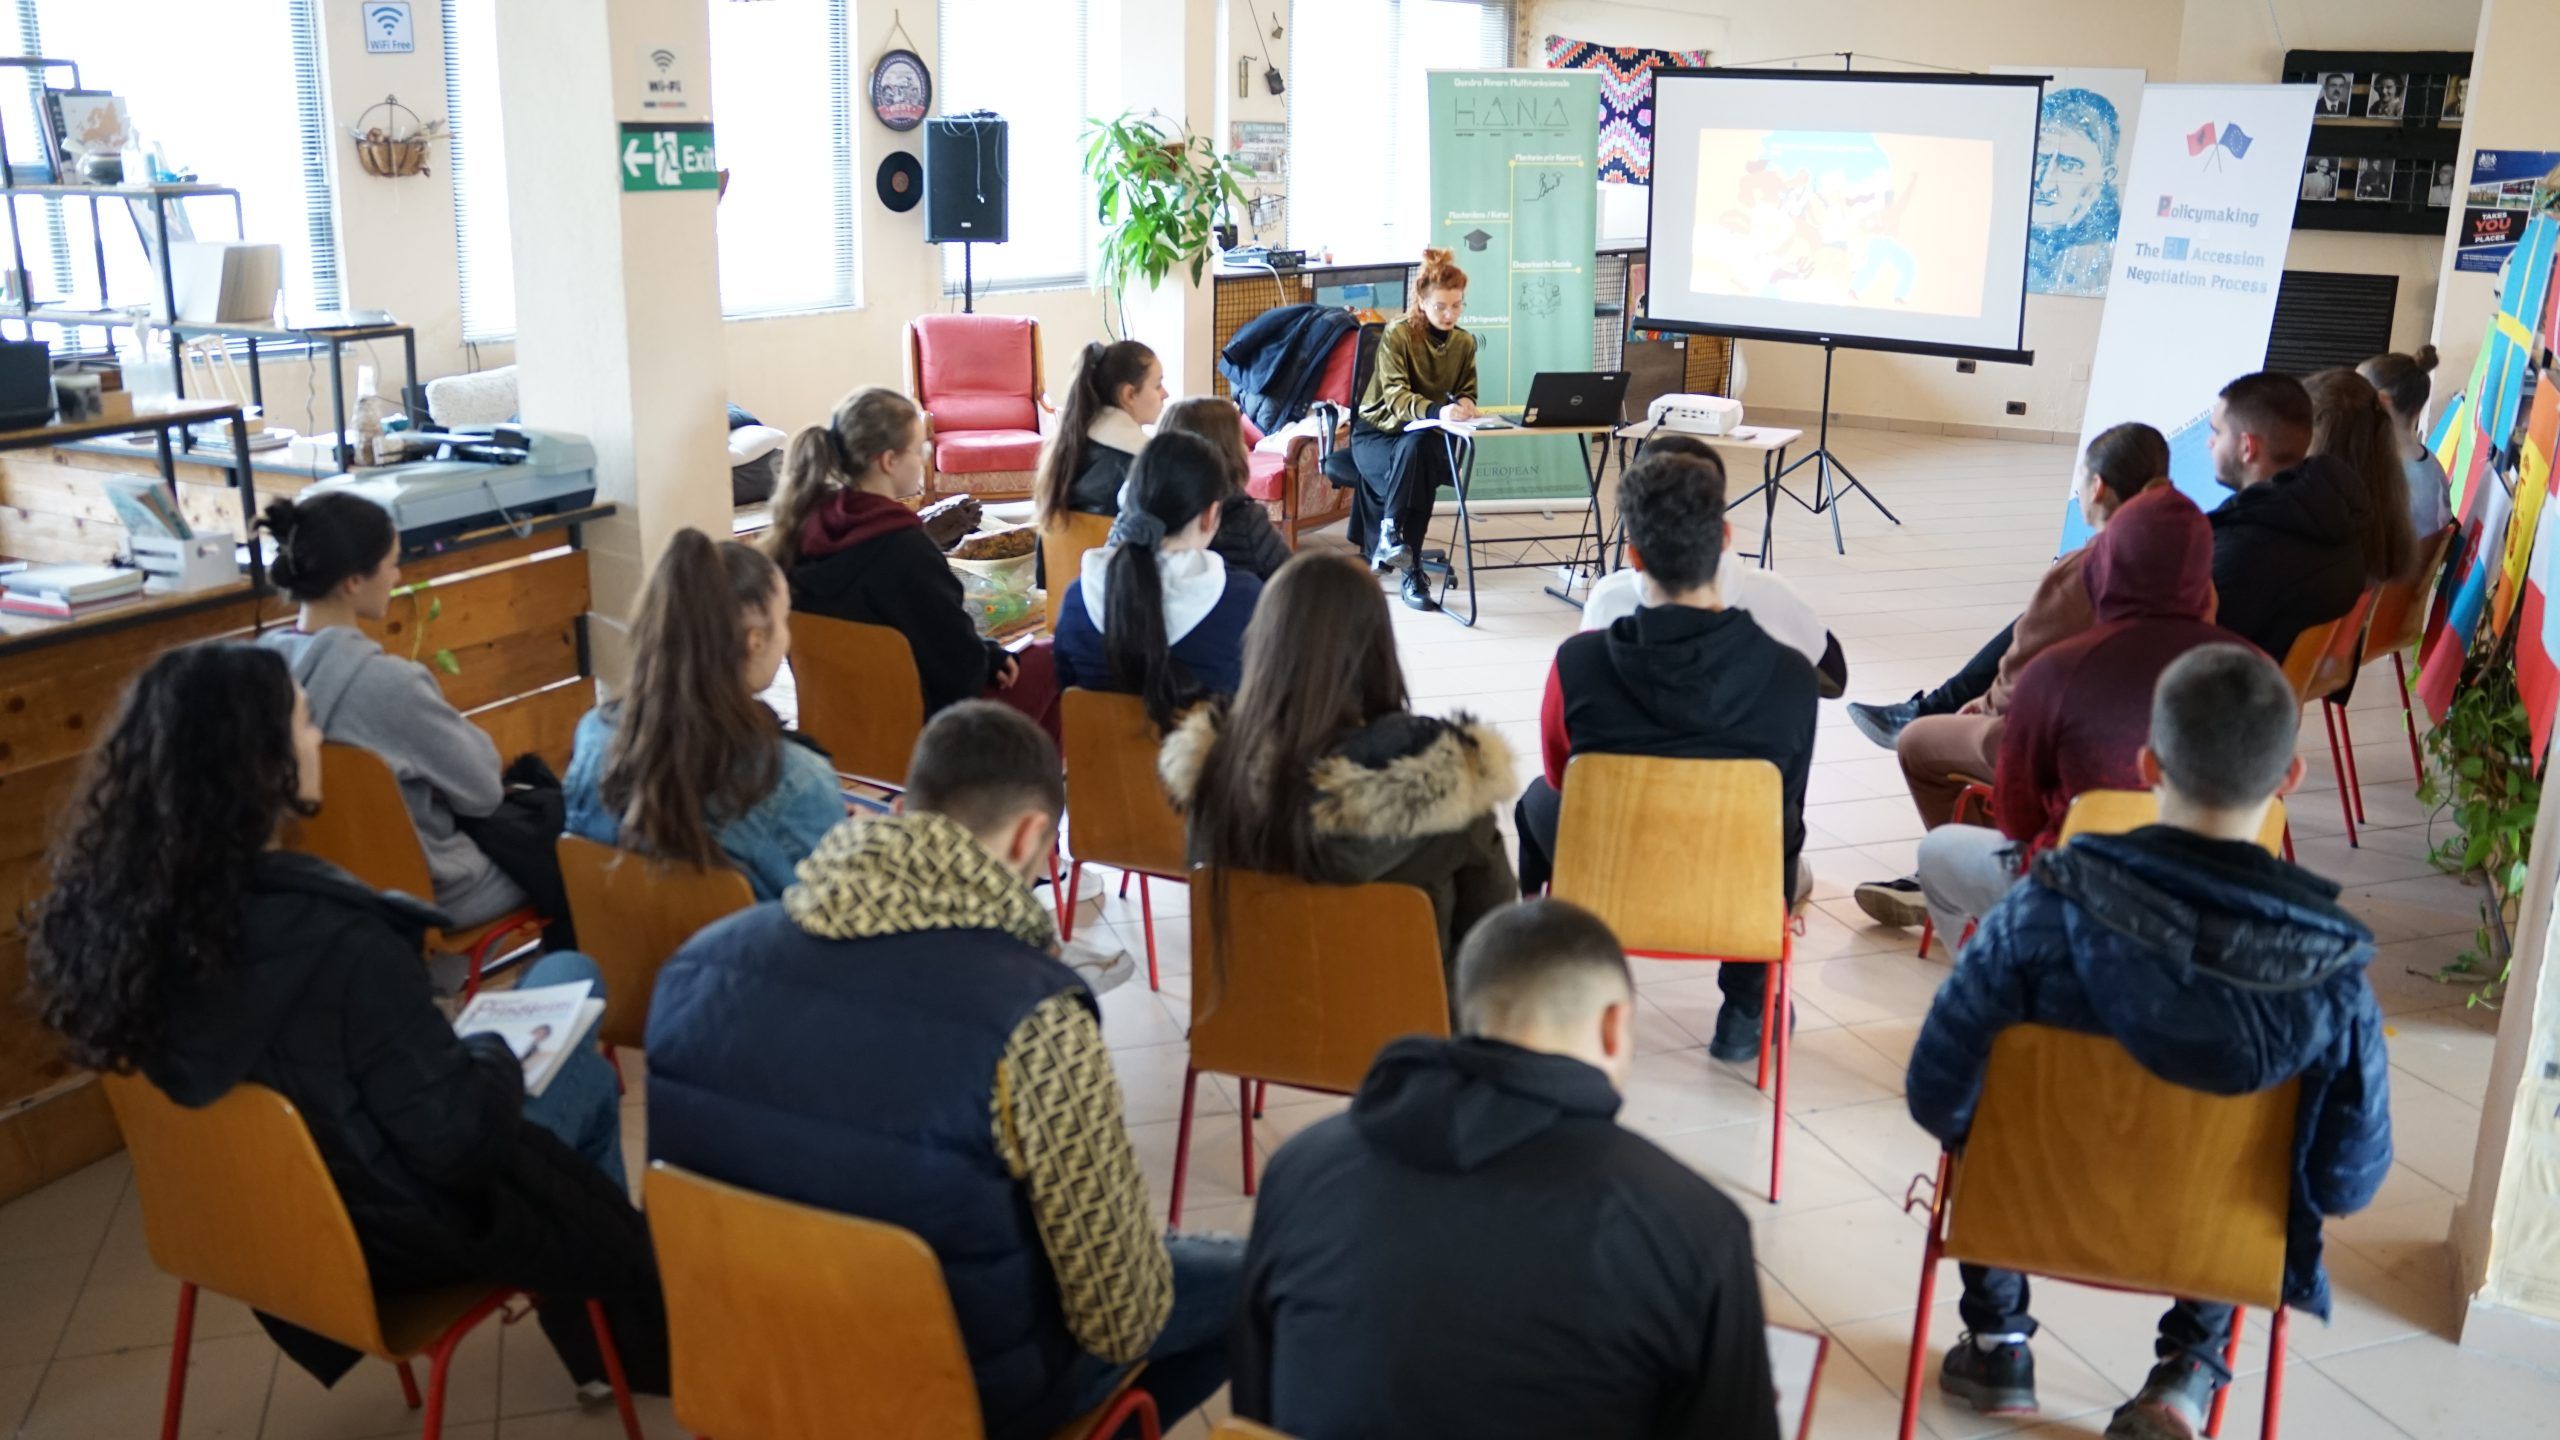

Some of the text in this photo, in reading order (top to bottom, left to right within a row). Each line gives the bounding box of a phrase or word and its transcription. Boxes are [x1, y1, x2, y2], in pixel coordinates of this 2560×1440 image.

[370, 40, 411, 49] WiFi Free
[648, 80, 681, 92] Wi-Fi
[2157, 195, 2260, 227] Policymaking
[2482, 211, 2508, 220] TAKES
[2475, 217, 2512, 232] YOU
[2475, 234, 2506, 243] PLACES
[2136, 243, 2160, 258] The
[2192, 247, 2265, 267] Accession
[2127, 265, 2268, 294] Negotiation Process
[1475, 464, 1540, 478] EUROPEAN
